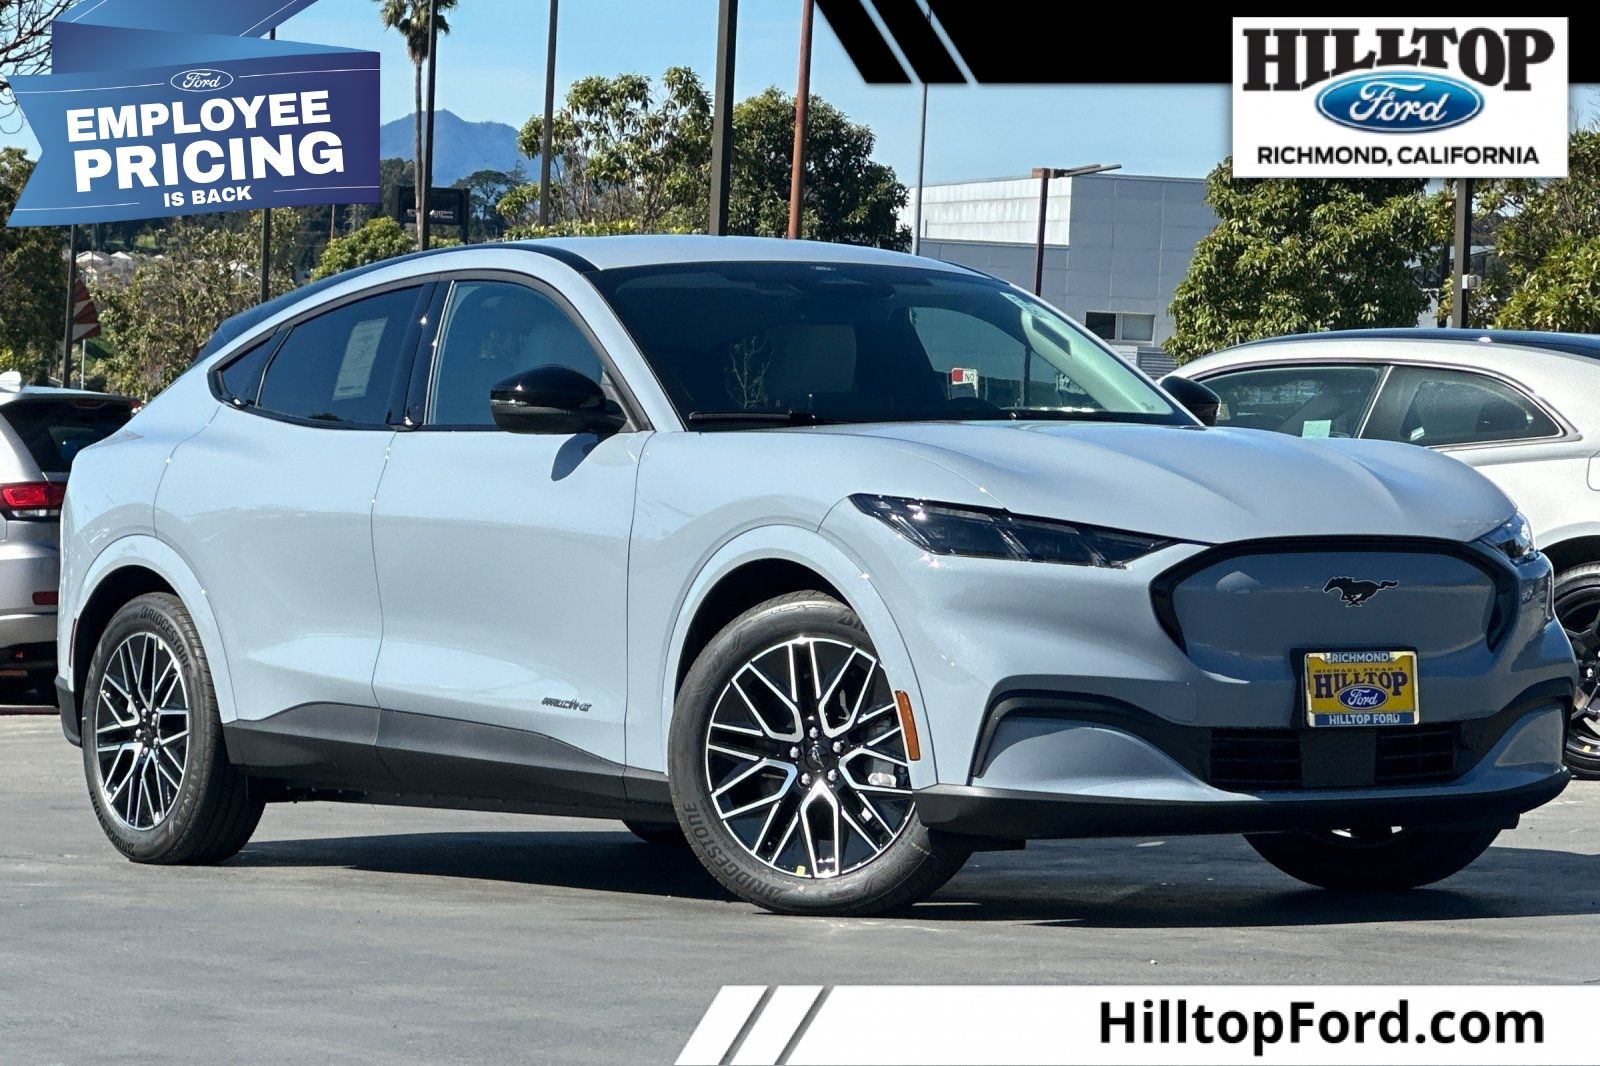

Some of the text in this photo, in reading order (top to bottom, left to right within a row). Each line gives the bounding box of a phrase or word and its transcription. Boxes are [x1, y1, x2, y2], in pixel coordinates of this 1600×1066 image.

[140, 605, 192, 673] BRIDGESTONE
[1331, 652, 1389, 663] RICHMOND
[1313, 672, 1408, 698] HILLTOP
[1348, 689, 1378, 706] Ford
[1328, 713, 1400, 725] HILLTOP FORD
[683, 801, 786, 899] BRIDGESTONE
